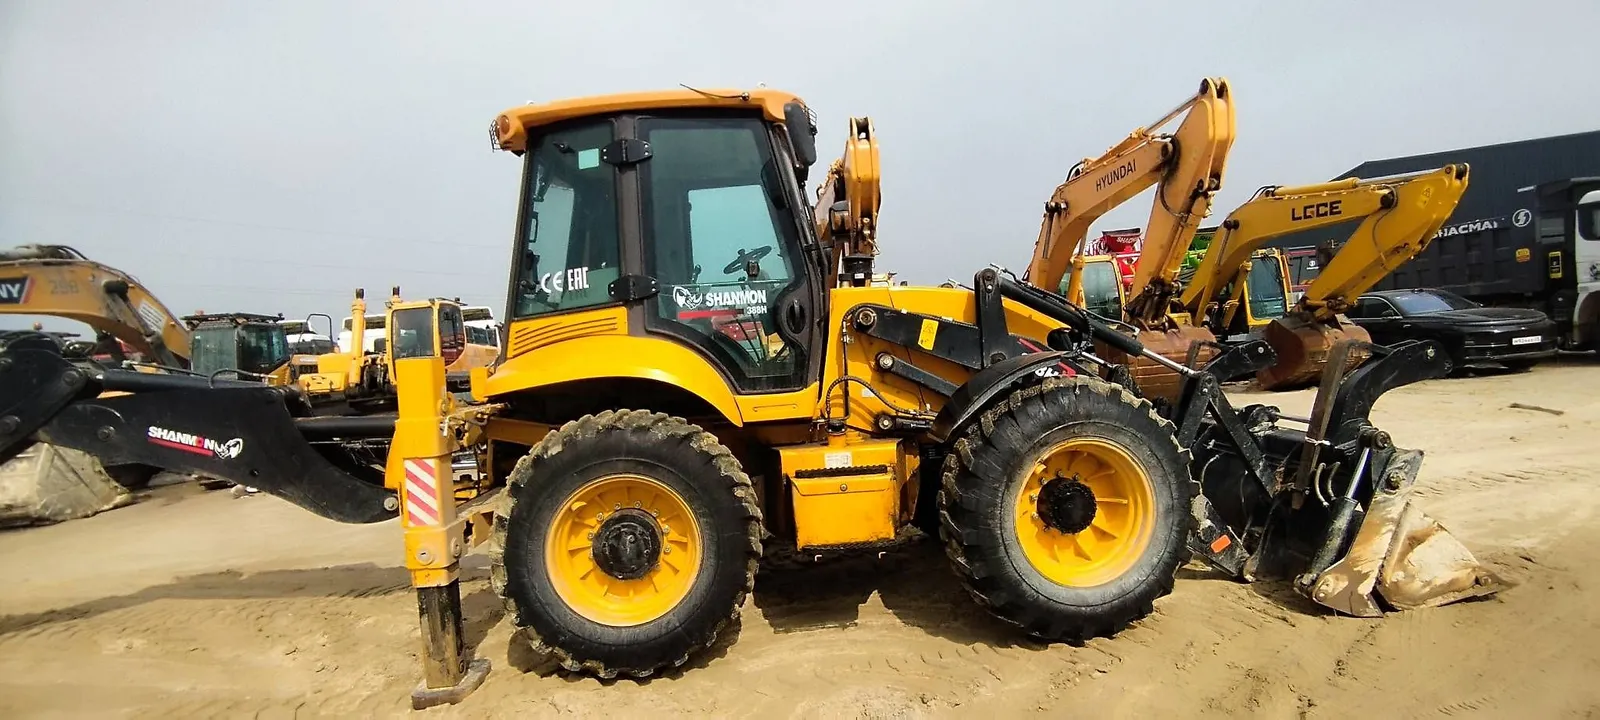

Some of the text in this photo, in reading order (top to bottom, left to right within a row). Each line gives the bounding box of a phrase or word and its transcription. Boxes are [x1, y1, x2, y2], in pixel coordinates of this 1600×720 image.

[1095, 159, 1137, 192] HYUNDAI
[541, 271, 564, 294] CE
[705, 290, 767, 307] SHANMON
[746, 306, 768, 315] 388H
[147, 426, 215, 450] SHANMON
